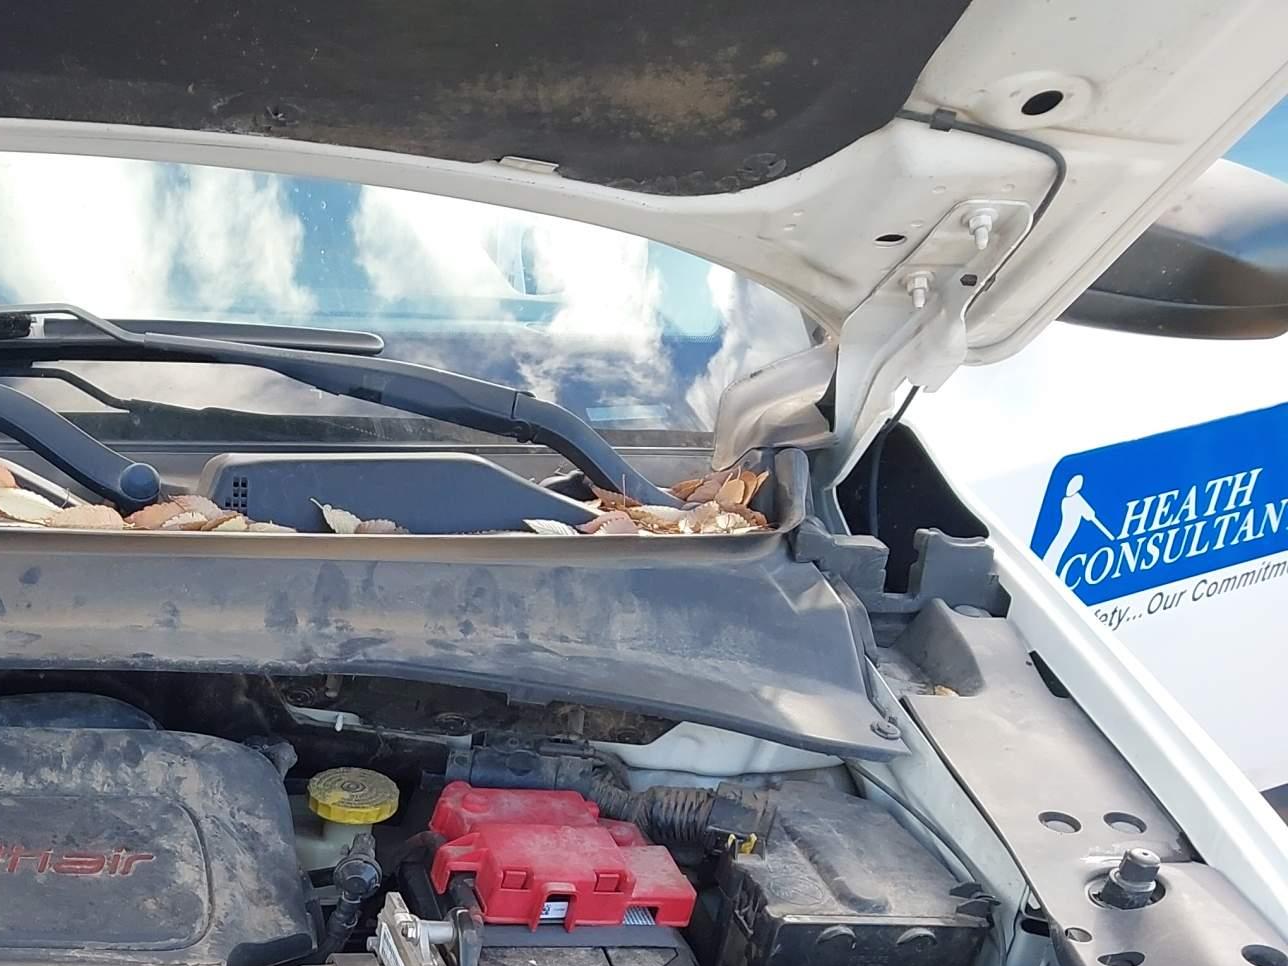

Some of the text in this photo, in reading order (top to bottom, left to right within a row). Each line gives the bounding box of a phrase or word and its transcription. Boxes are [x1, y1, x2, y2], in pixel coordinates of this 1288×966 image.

[1117, 467, 1264, 540] HEATH
[1059, 498, 1288, 591] CONSULTAN
[1147, 589, 1188, 615] Our
[1191, 560, 1288, 602] Commitm
